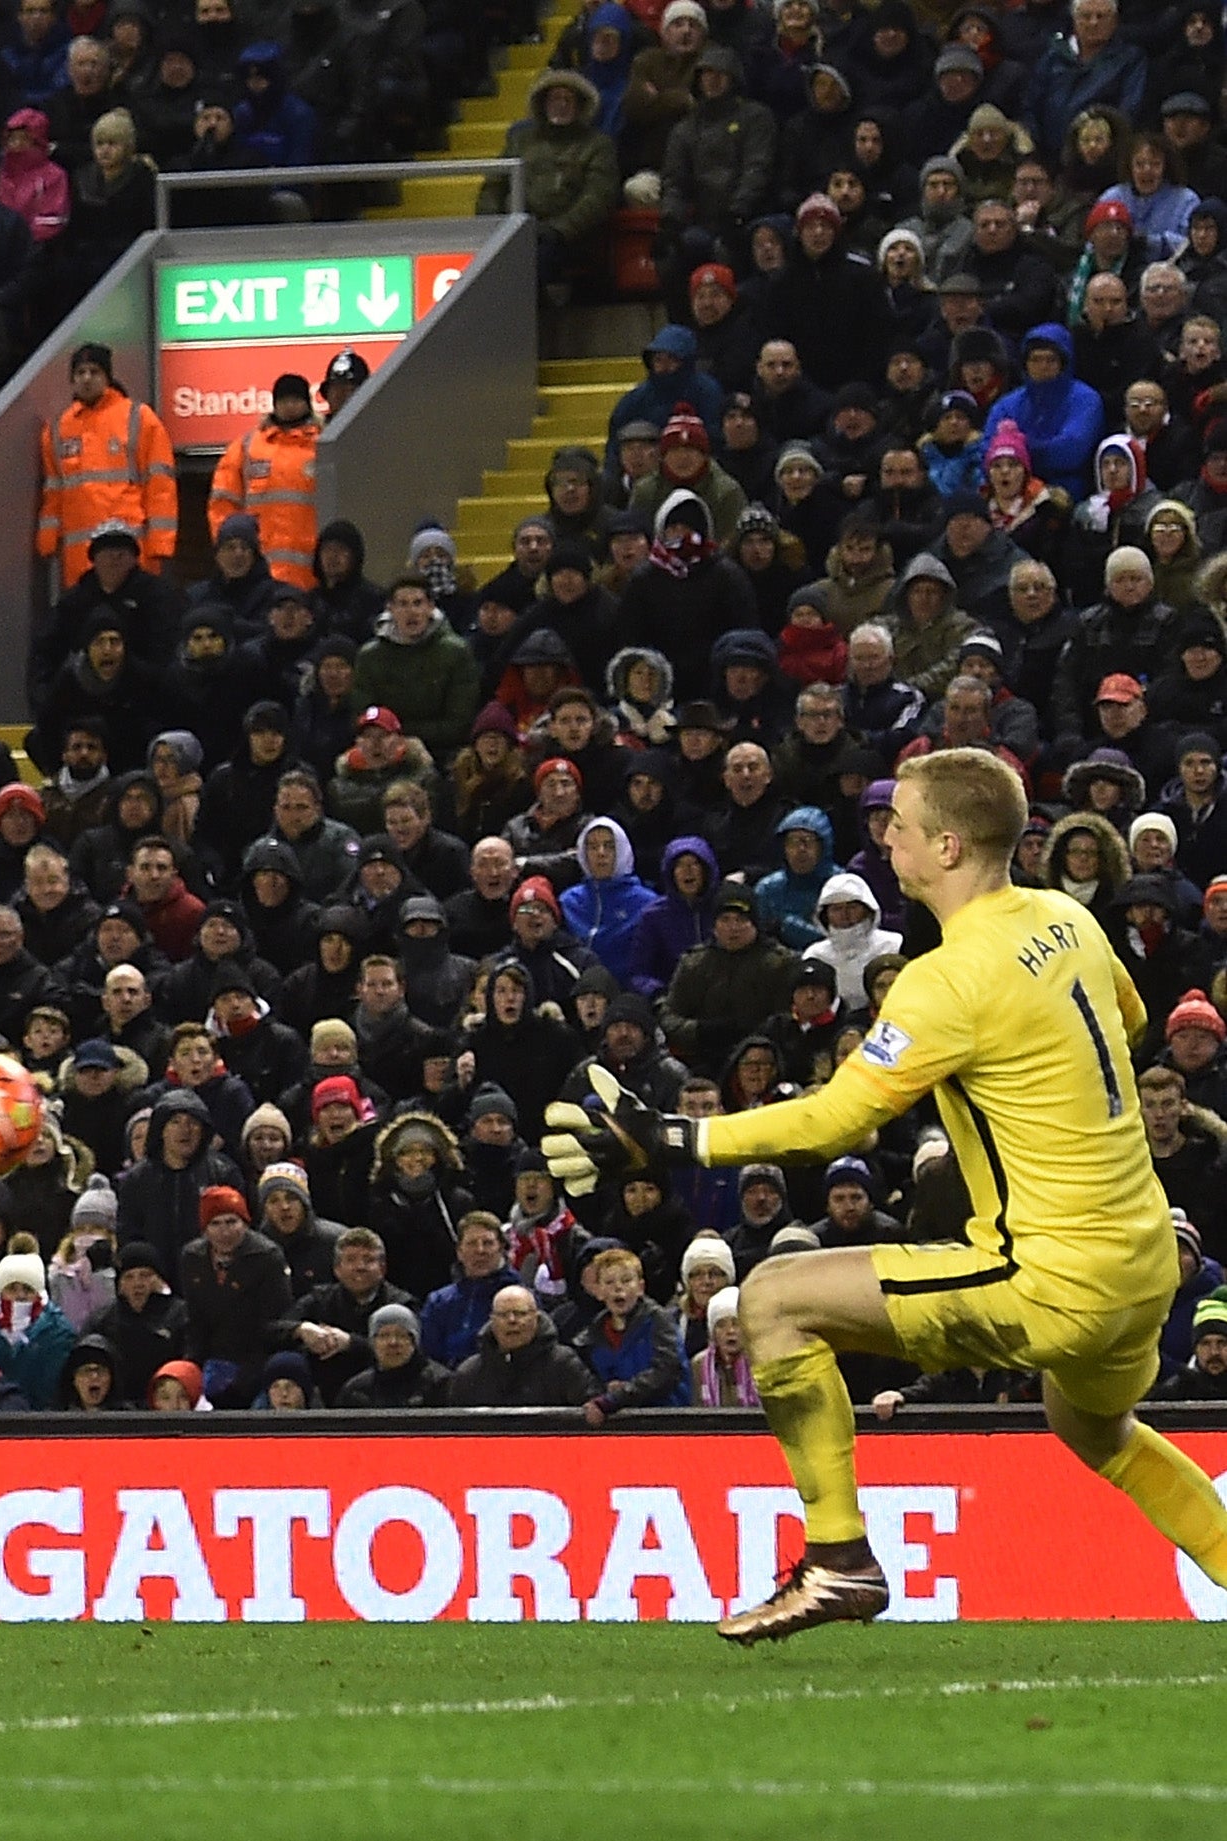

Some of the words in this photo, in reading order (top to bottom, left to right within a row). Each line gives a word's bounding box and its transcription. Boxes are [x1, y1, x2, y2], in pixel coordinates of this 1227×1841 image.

[175, 276, 288, 326] EXIT
[174, 385, 274, 418] Standa
[1017, 921, 1080, 977] HART
[1071, 977, 1123, 1119] 1
